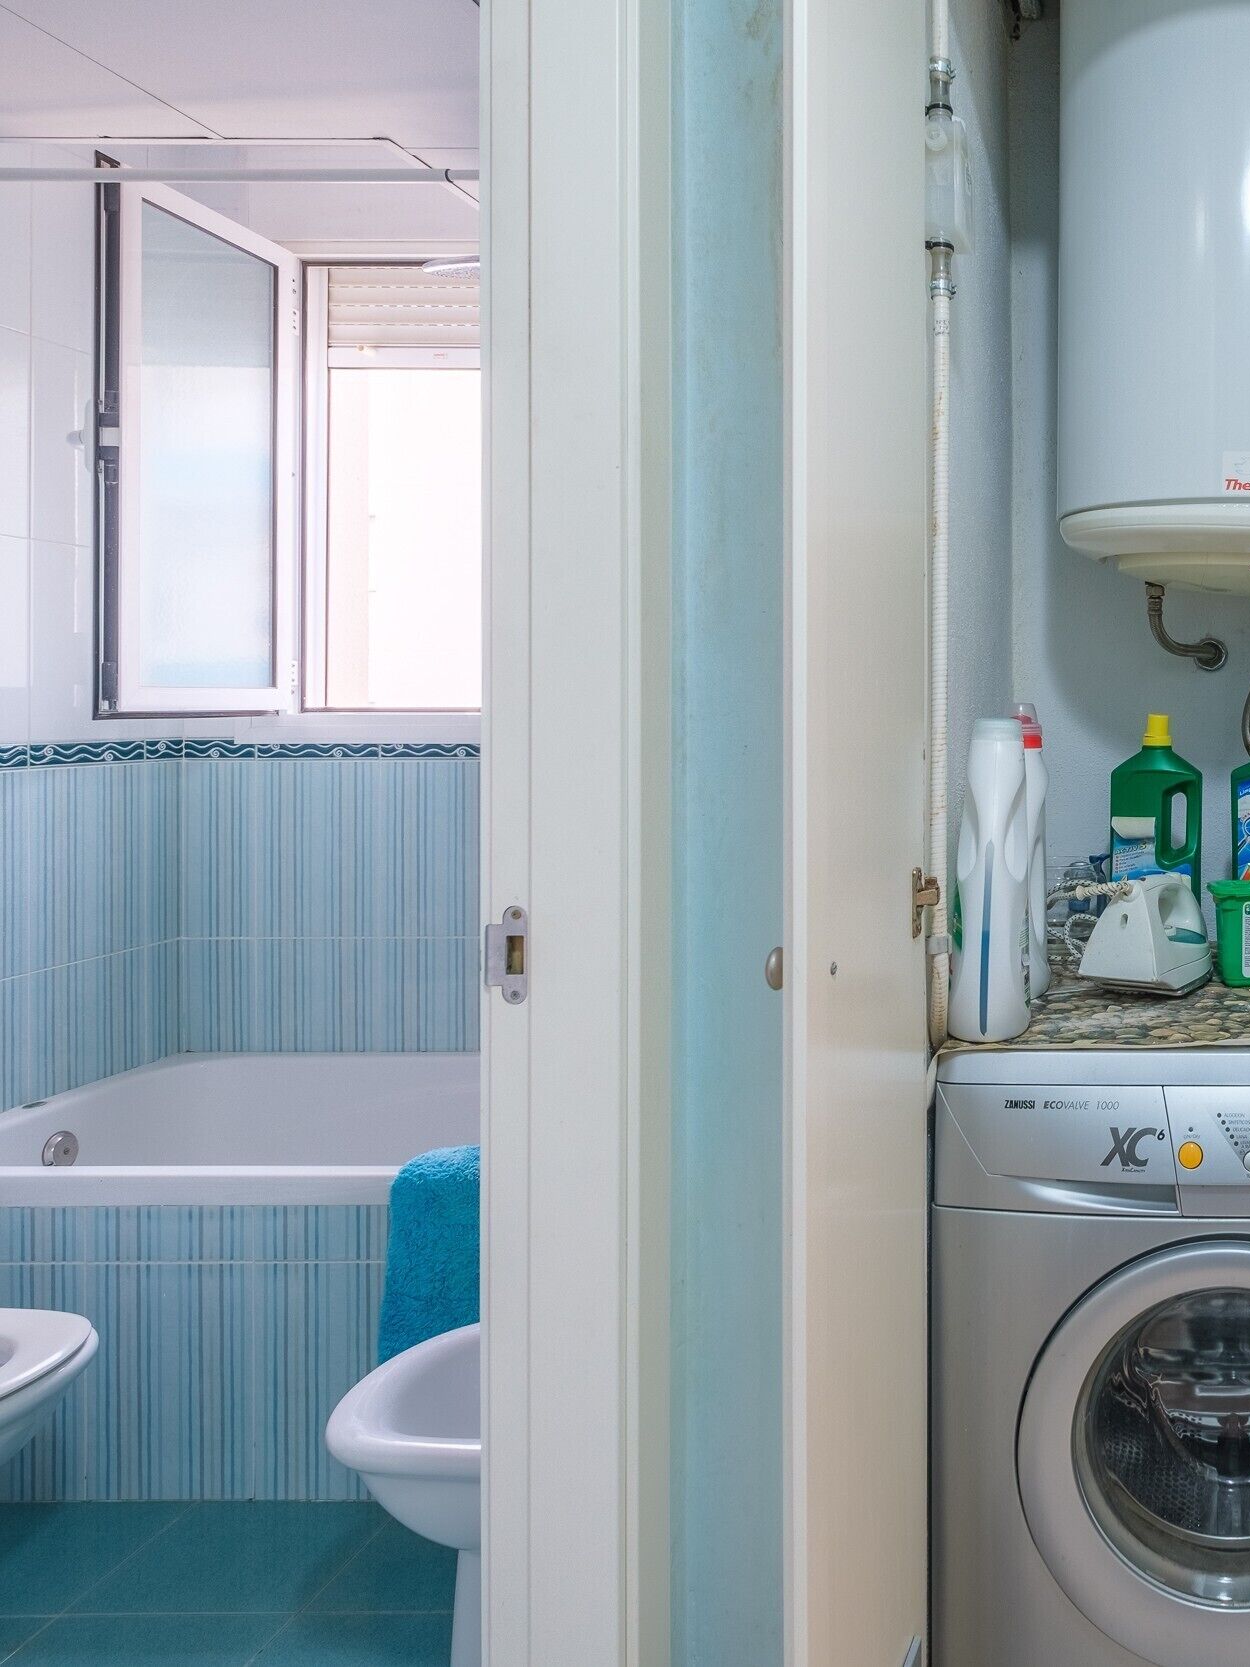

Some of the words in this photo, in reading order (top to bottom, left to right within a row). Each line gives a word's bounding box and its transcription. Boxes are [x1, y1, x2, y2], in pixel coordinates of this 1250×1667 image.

[1004, 1100, 1035, 1109] ZANUSSI
[1043, 1100, 1090, 1110] ECOVALVE
[1096, 1100, 1120, 1110] 1000
